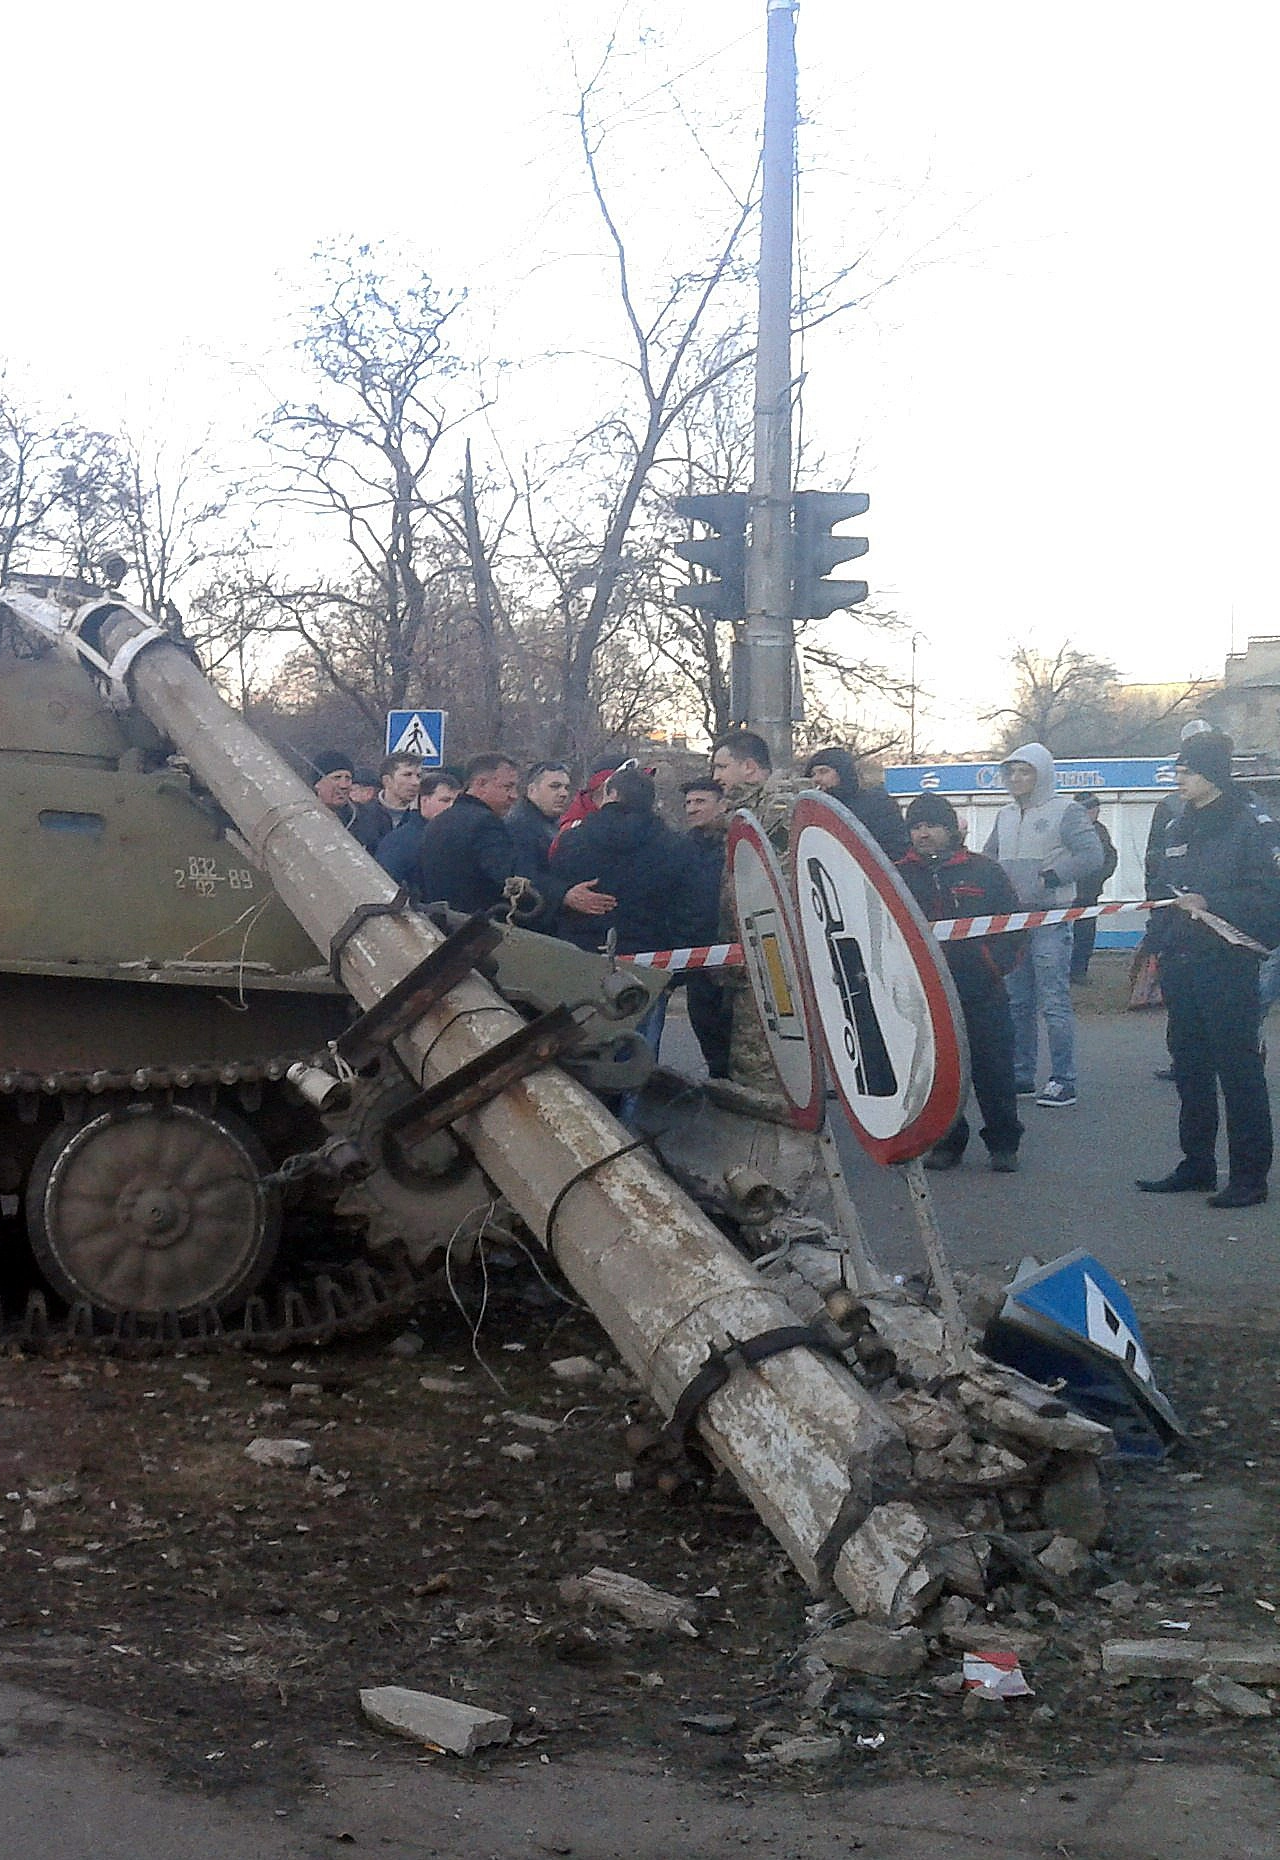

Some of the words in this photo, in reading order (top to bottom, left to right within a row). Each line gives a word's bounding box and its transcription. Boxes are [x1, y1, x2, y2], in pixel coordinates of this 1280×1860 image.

[188, 856, 217, 876] 832
[174, 869, 185, 889] 2
[228, 869, 253, 889] 89
